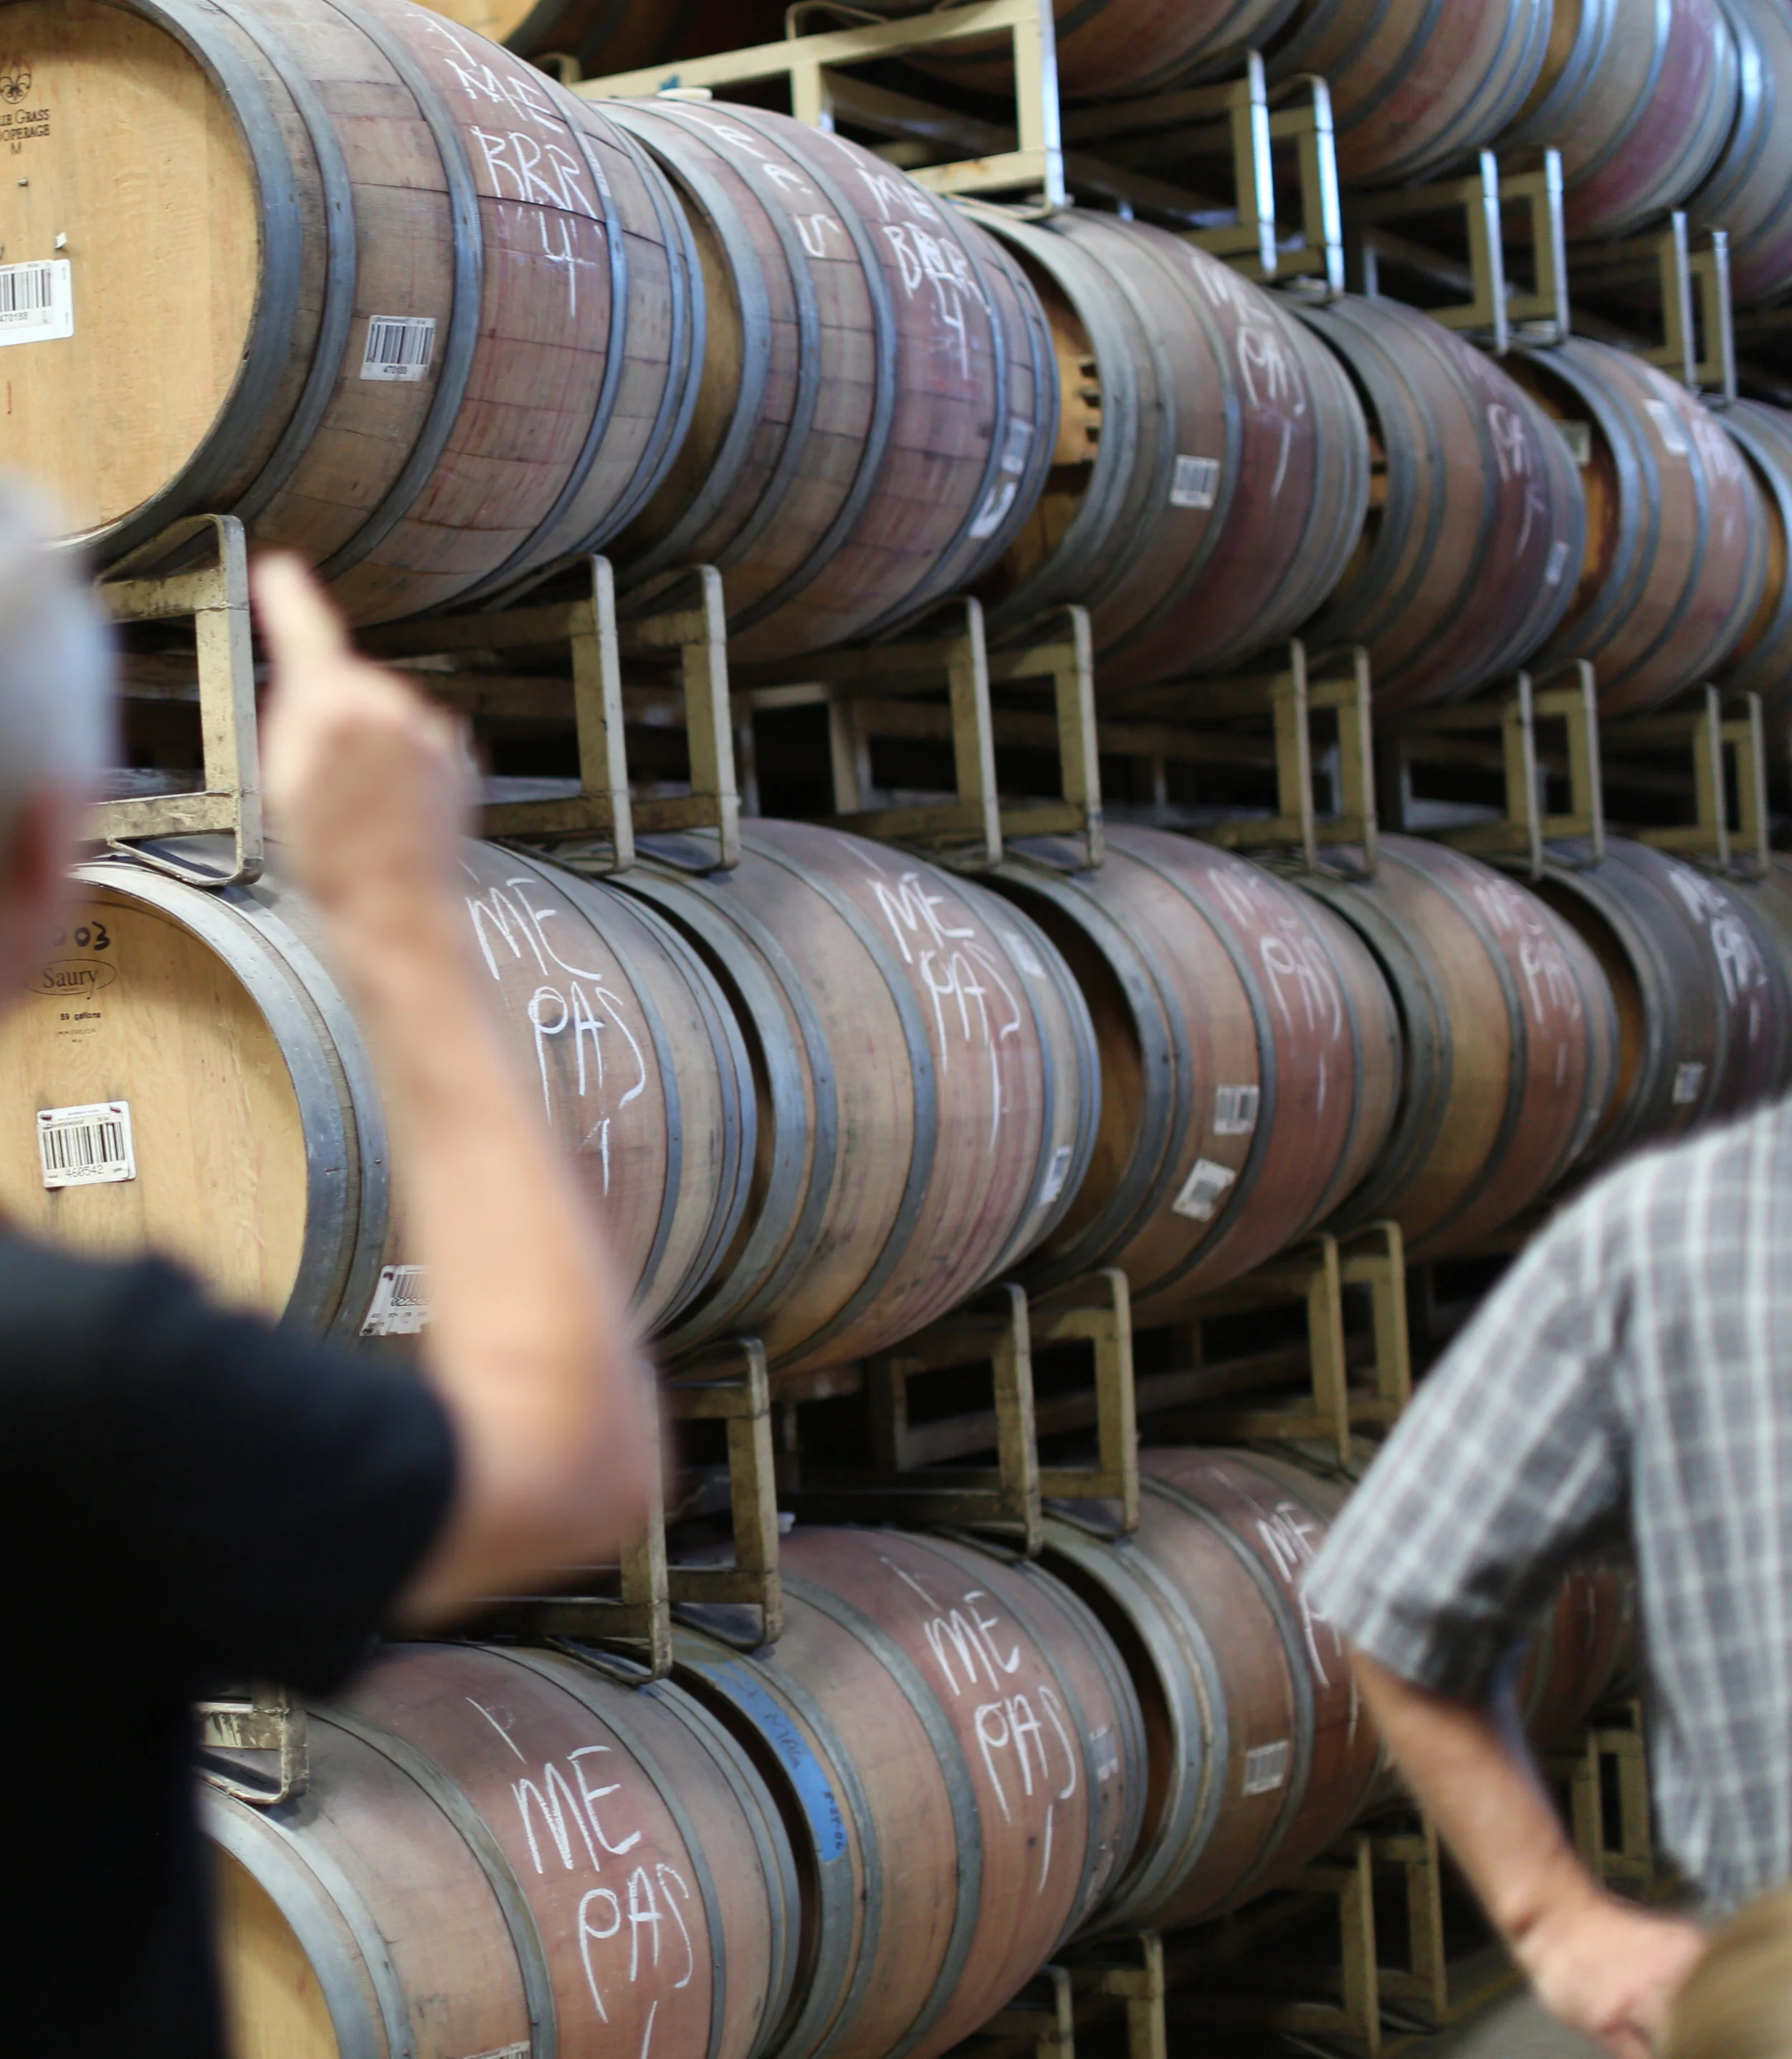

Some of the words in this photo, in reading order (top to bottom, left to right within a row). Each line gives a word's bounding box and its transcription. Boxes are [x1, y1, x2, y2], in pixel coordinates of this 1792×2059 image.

[0, 124, 50, 142] OPERAGE
[442, 57, 566, 135] ME
[856, 166, 940, 224] ME
[465, 876, 602, 980] ME
[866, 871, 976, 964] ME
[42, 968, 99, 1000] Saury
[74, 1011, 102, 1021] gallons
[919, 939, 1021, 1075] PAS
[527, 980, 646, 1128] PAS
[576, 1115, 612, 1197] 1
[924, 1590, 1020, 1697] ME
[973, 1685, 1077, 1824] PAS
[510, 1744, 642, 1875] ME
[577, 1863, 694, 2025] PAS
